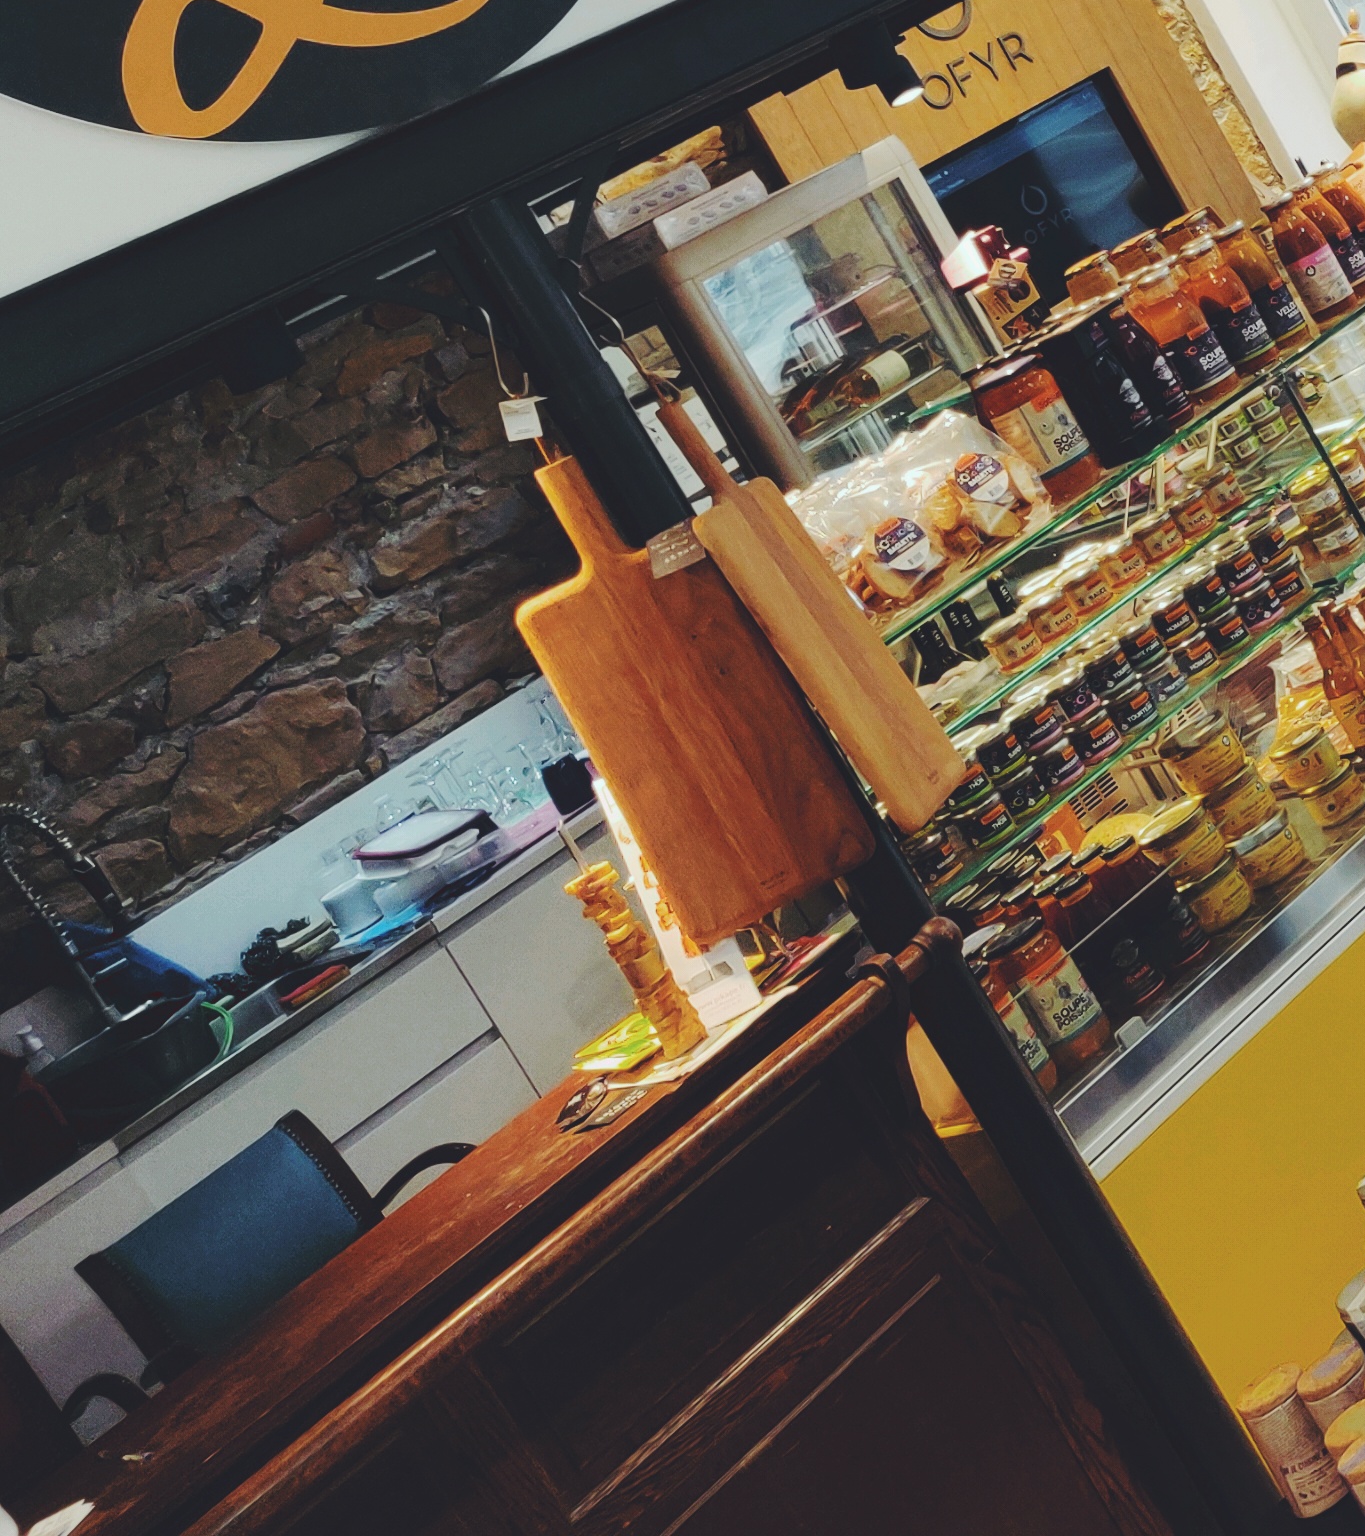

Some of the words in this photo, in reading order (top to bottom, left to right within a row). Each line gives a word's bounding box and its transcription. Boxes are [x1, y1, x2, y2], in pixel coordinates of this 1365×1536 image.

[920, 31, 1033, 111] OFYR
[1025, 206, 1080, 248] OFYR
[1276, 305, 1301, 318] VELO
[1052, 993, 1087, 1022] SOUPE
[1057, 1001, 1095, 1031] POISSON
